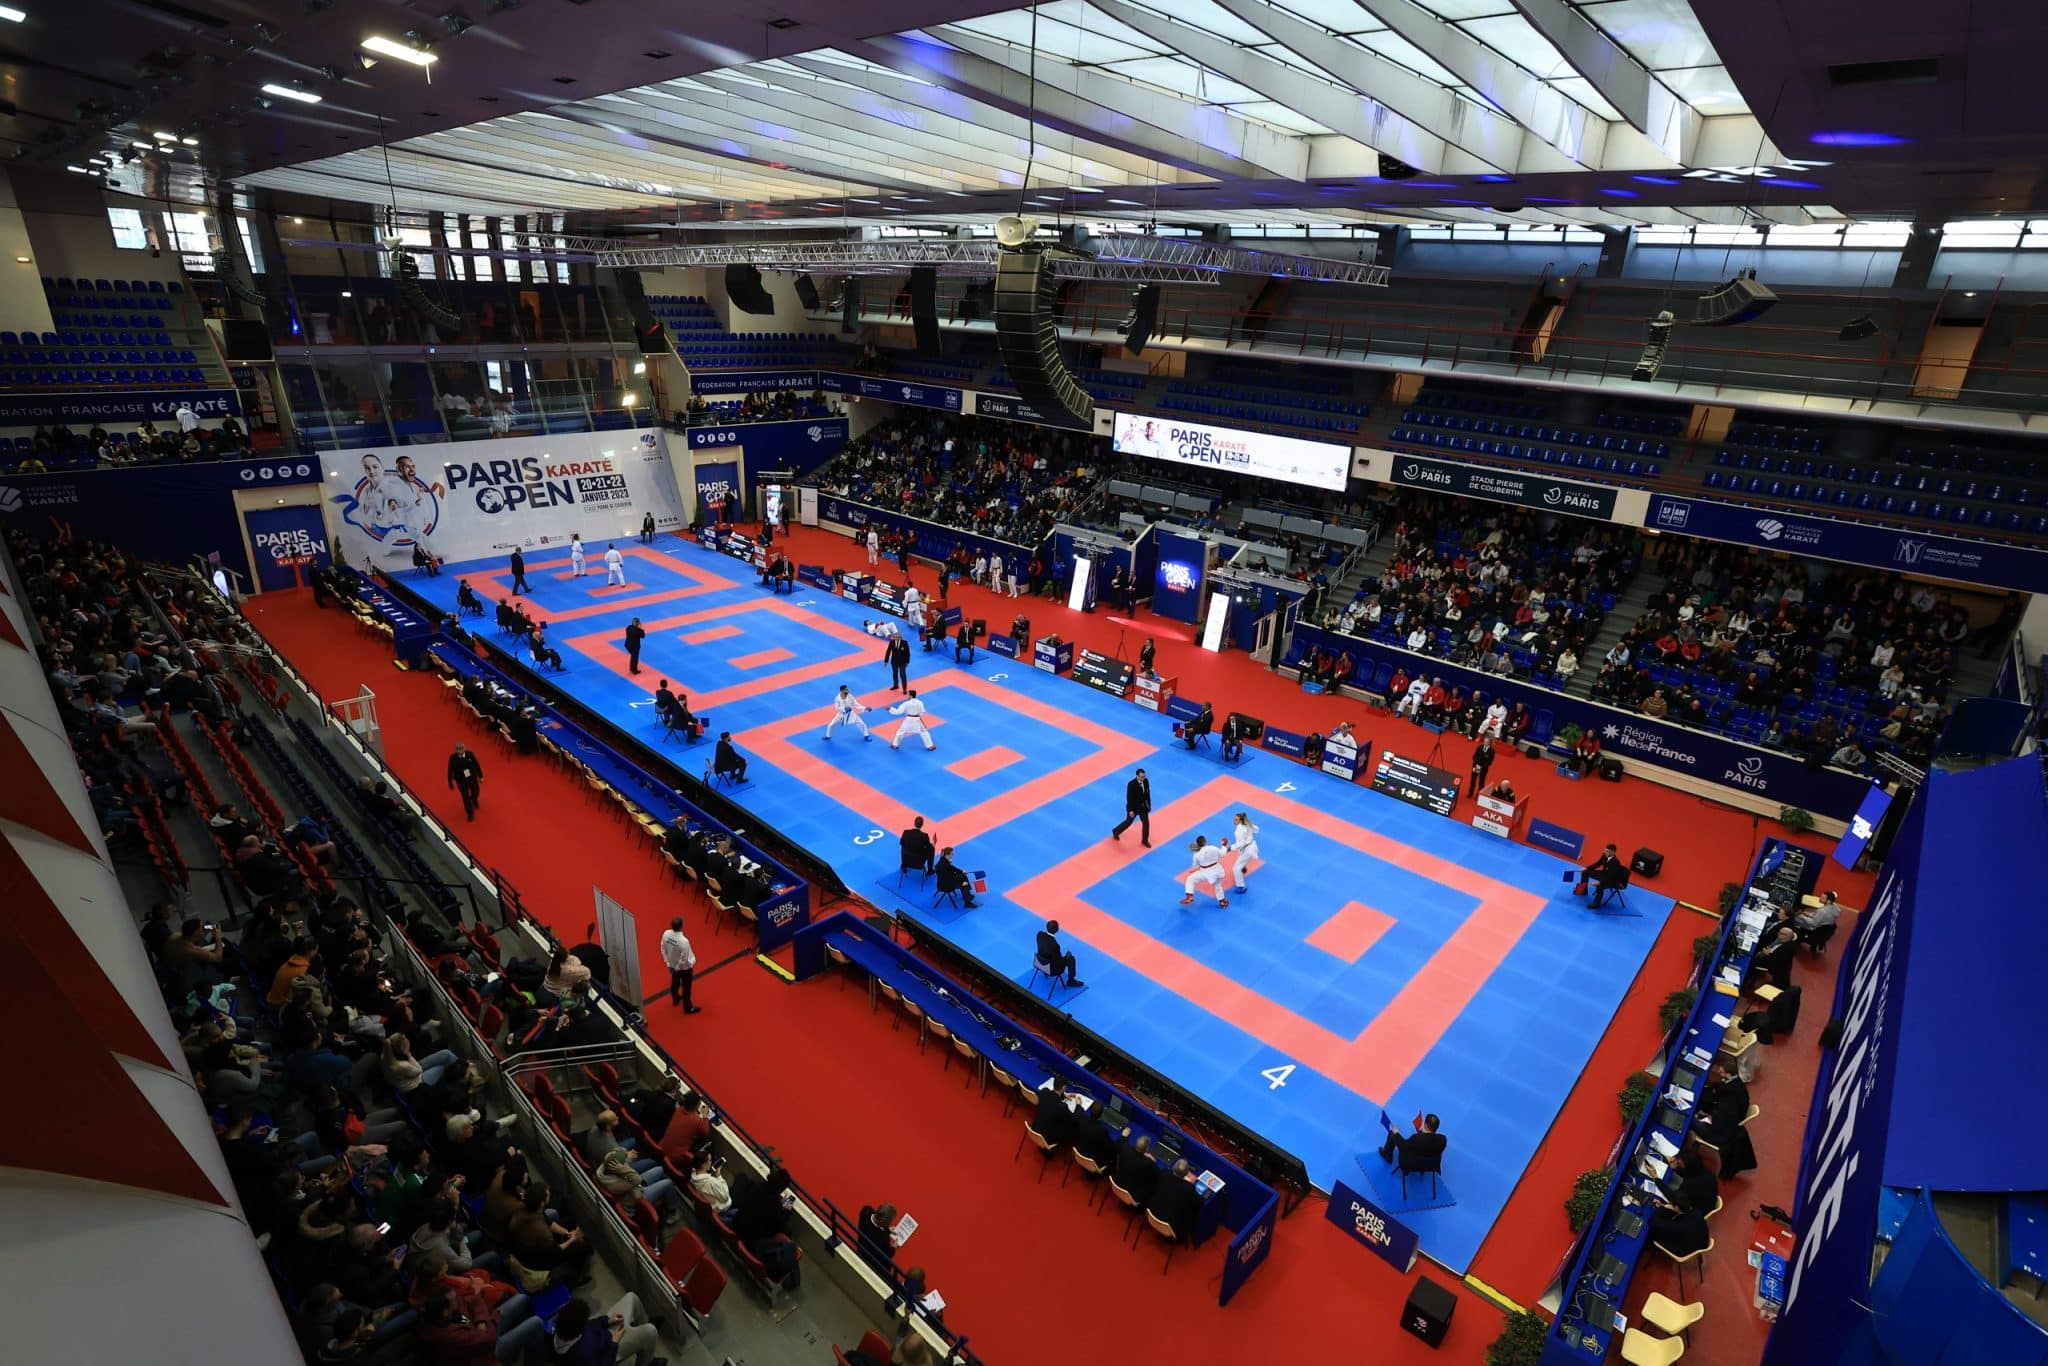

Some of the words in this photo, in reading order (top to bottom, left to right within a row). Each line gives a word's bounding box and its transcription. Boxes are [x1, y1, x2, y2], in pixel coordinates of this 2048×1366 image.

[1170, 428, 1212, 447] PARIS
[1178, 443, 1222, 465] OPEN
[444, 457, 544, 491] PARIS
[1420, 472, 1452, 485] PARIS
[1470, 475, 1494, 485] STADE
[1496, 479, 1525, 490] PIERRE
[476, 480, 575, 514] OPEN
[697, 481, 729, 494] PARIS
[1469, 482, 1479, 490] DE
[1480, 484, 1523, 497] COUBERTIN
[1563, 495, 1600, 510] PARIS
[255, 529, 310, 548] PARIS
[1622, 724, 1663, 745] Région
[1332, 756, 1346, 766] AO
[1724, 769, 1768, 791] PARIS
[1482, 810, 1503, 824] AKA
[854, 830, 884, 845] 3
[767, 901, 793, 919] PARIS
[1261, 1064, 1297, 1090] 4
[1350, 1201, 1386, 1232] PARIS
[1356, 1215, 1391, 1247] OPEN
